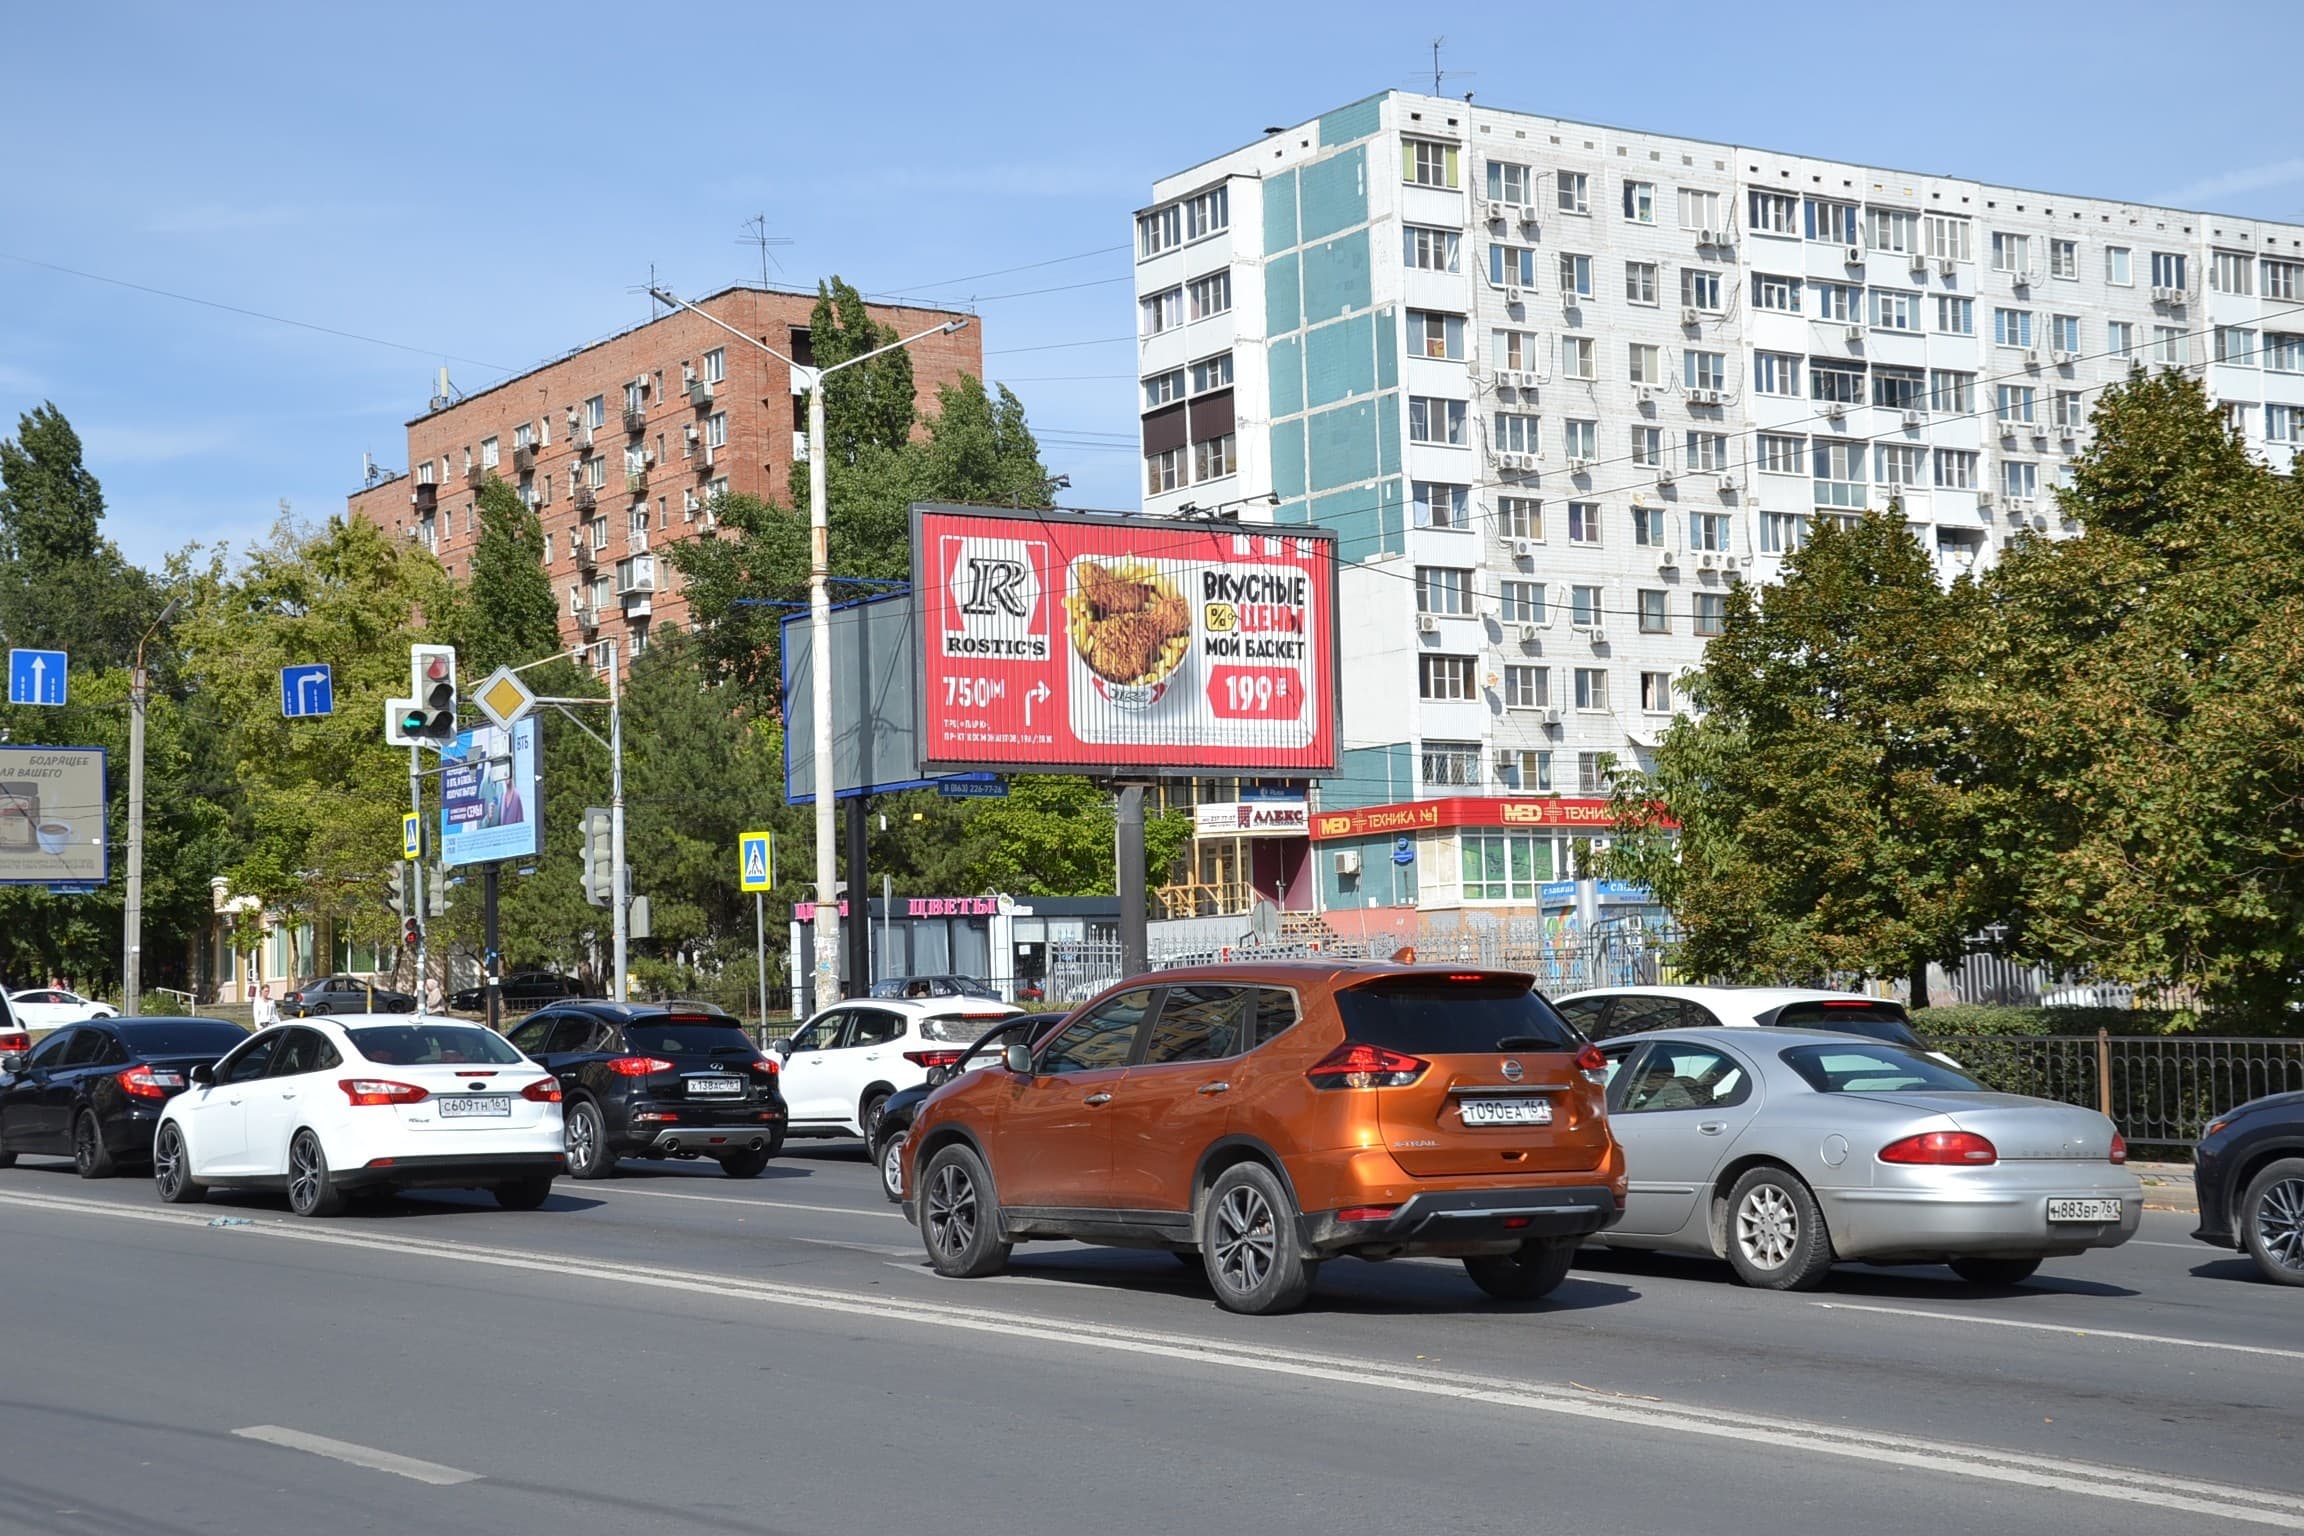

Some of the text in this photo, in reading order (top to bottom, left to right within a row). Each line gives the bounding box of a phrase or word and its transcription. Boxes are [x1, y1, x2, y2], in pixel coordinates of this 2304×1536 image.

[1203, 571, 1305, 605] ВКУСНЫЕ
[1240, 603, 1305, 635] ЦЕНЫ
[946, 637, 1046, 656] ROSTIC'S
[1205, 632, 1305, 660] МОЙ БАСКЕТ
[516, 735, 529, 751] ВТБ
[29, 755, 91, 767] БОДРЯЩЕЕ
[0, 767, 63, 778] ЛЯ ВАШЕГО
[1254, 810, 1304, 823] АЛЕКС
[1504, 804, 1616, 822] MED ТЕХНИК
[1321, 817, 1351, 836] MED
[1368, 810, 1416, 828] ТЕХНИКА
[908, 897, 997, 919] ЦВЕТЫ
[444, 1099, 488, 1112] С609ТН
[1468, 1102, 1522, 1120] Т090ЕА
